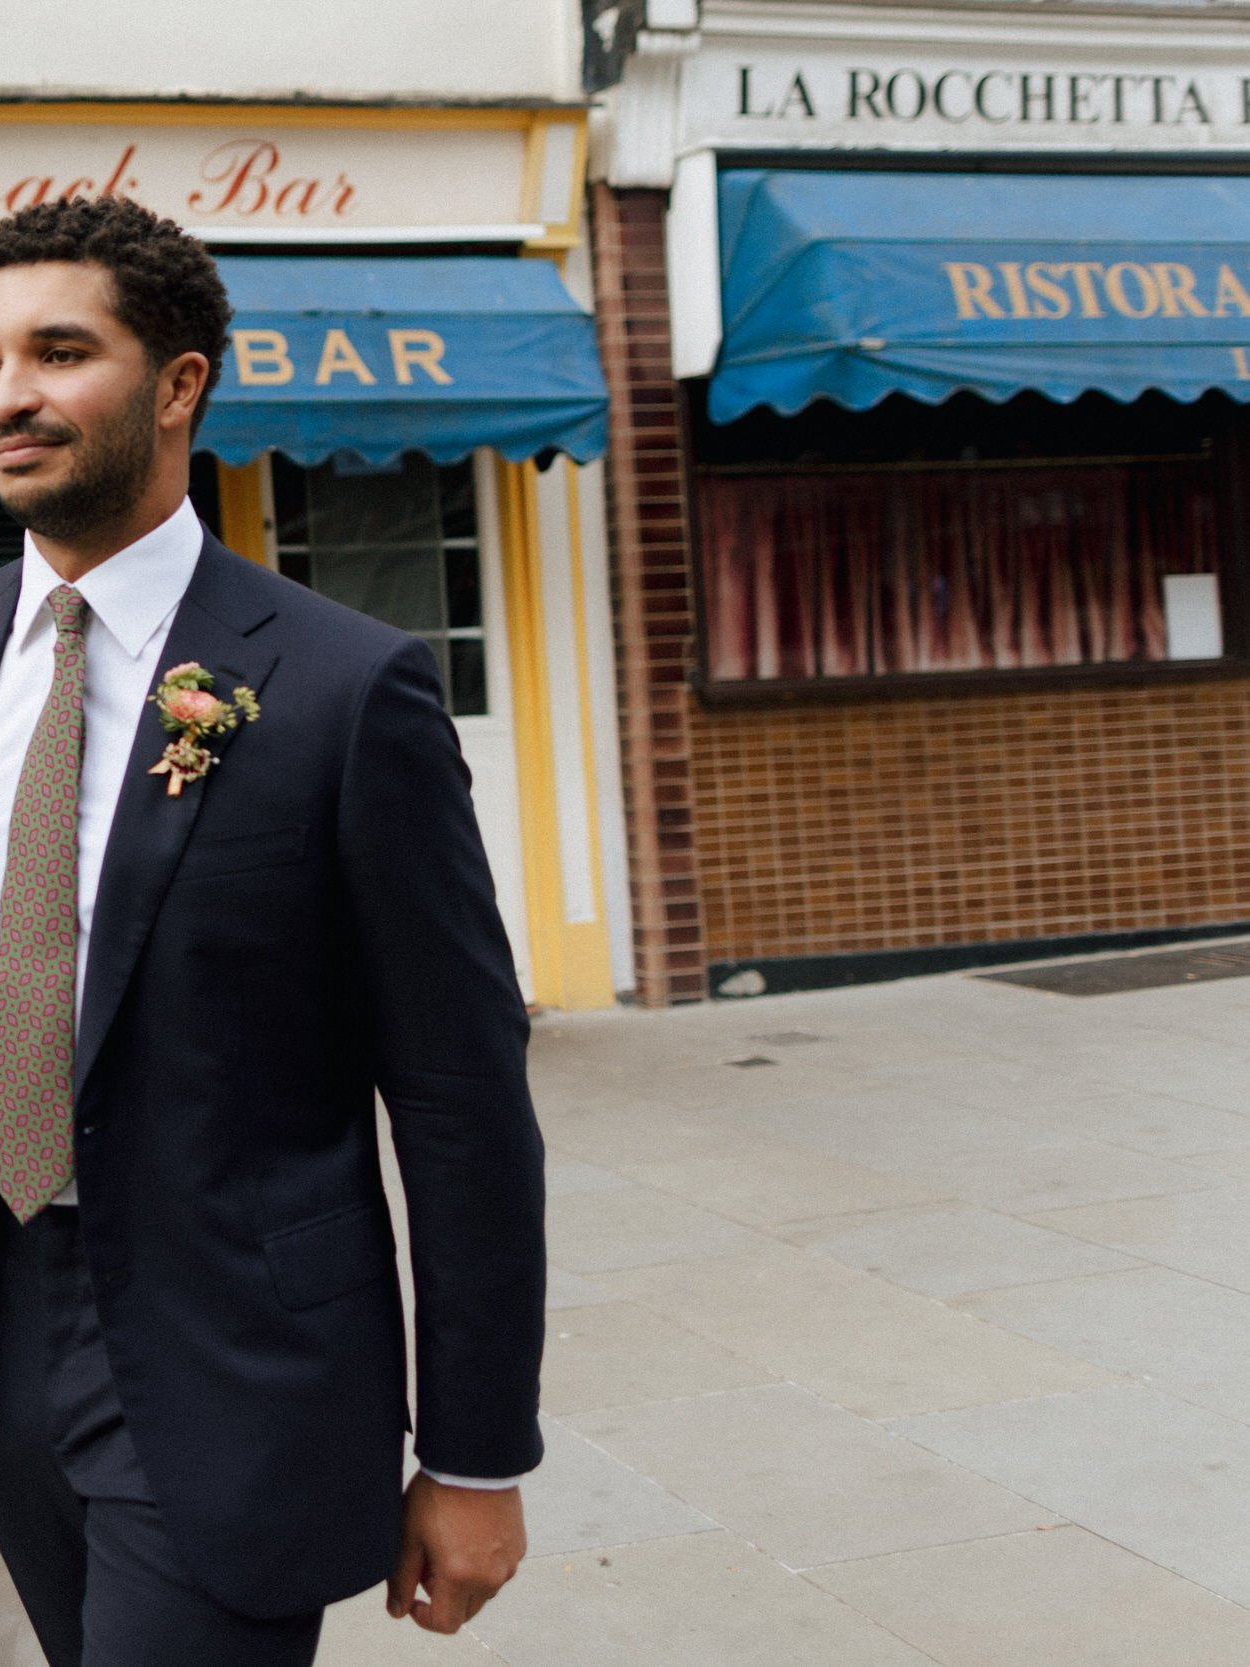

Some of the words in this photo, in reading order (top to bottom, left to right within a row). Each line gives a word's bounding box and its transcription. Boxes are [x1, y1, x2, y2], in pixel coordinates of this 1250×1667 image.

[736, 65, 816, 120] LA
[846, 67, 1212, 124] ROCCHETTA
[187, 138, 356, 216] Bar
[231, 329, 454, 386] BAR
